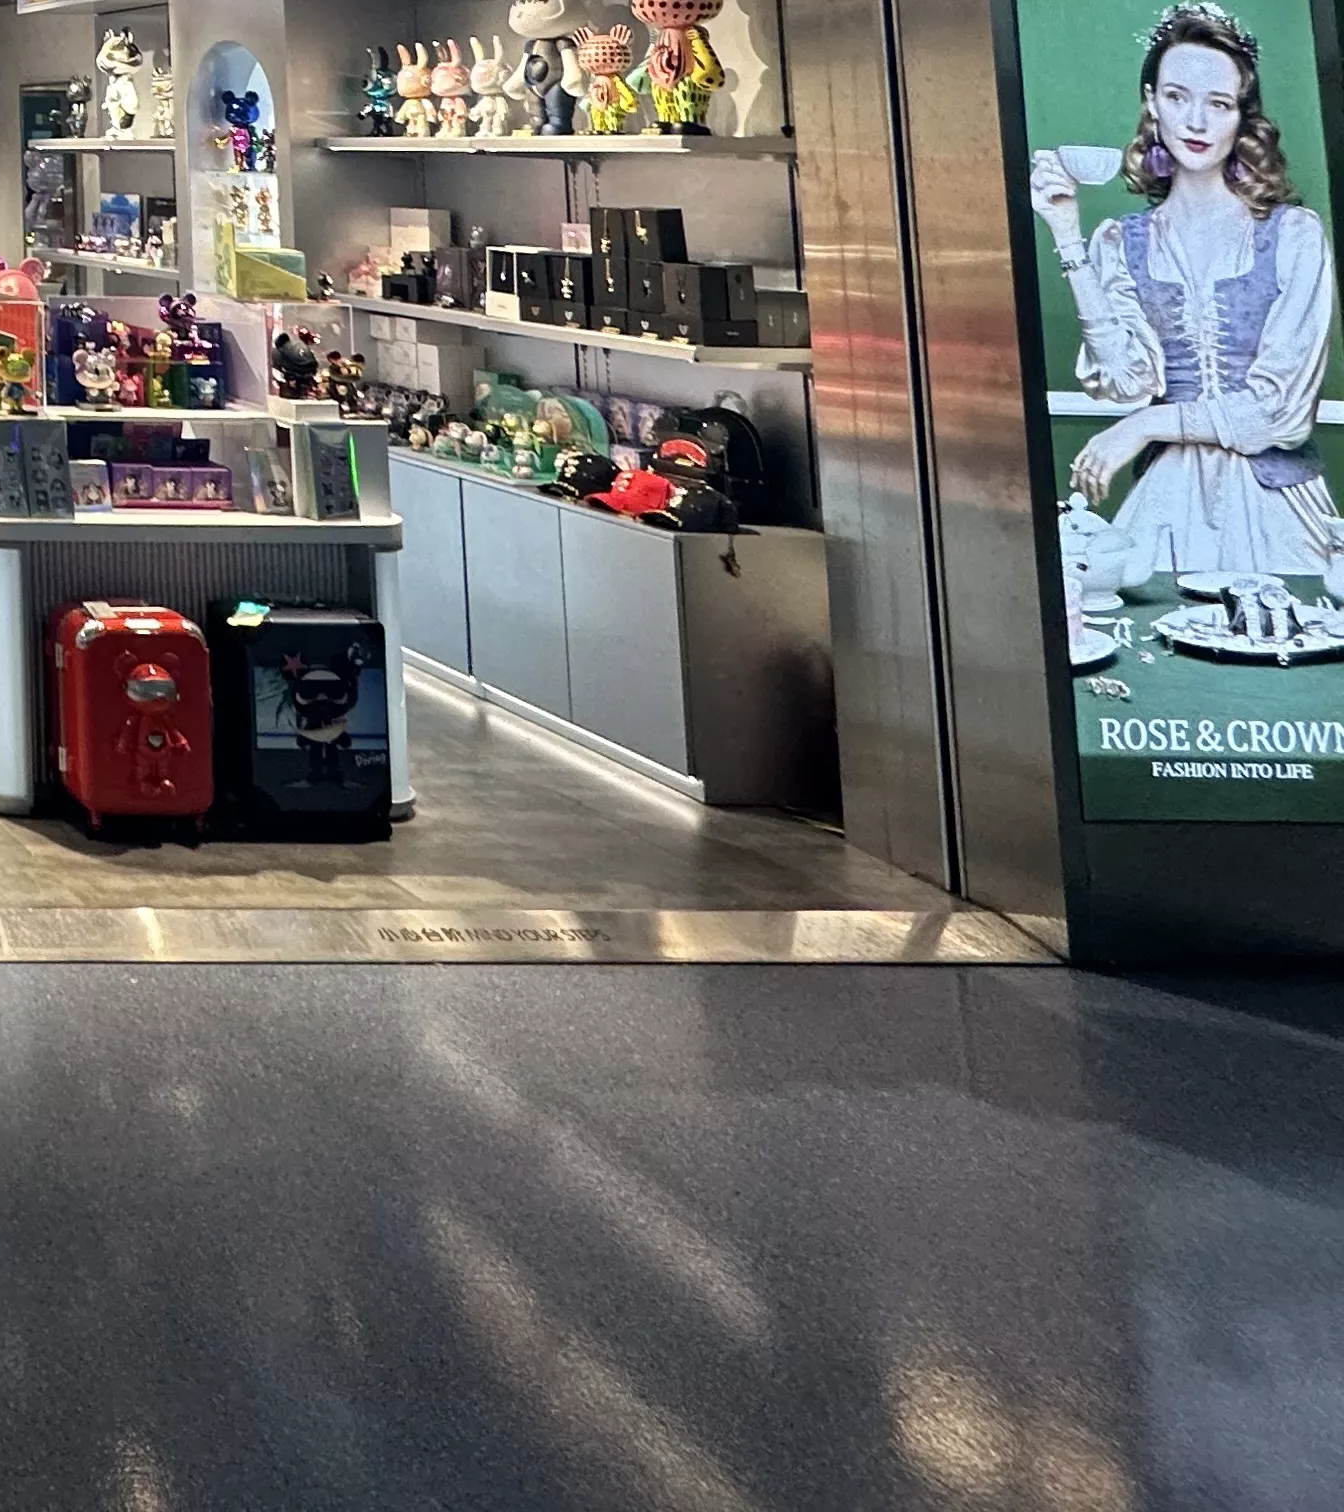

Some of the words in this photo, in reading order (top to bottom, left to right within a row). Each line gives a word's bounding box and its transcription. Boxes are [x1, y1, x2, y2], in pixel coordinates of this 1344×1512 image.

[1151, 761, 1226, 778] FASHION
[1230, 763, 1273, 779] INTO
[1275, 763, 1315, 780] LIFE
[464, 928, 514, 942] MIND
[512, 928, 565, 942] YOUR
[560, 928, 611, 942] STEPS
